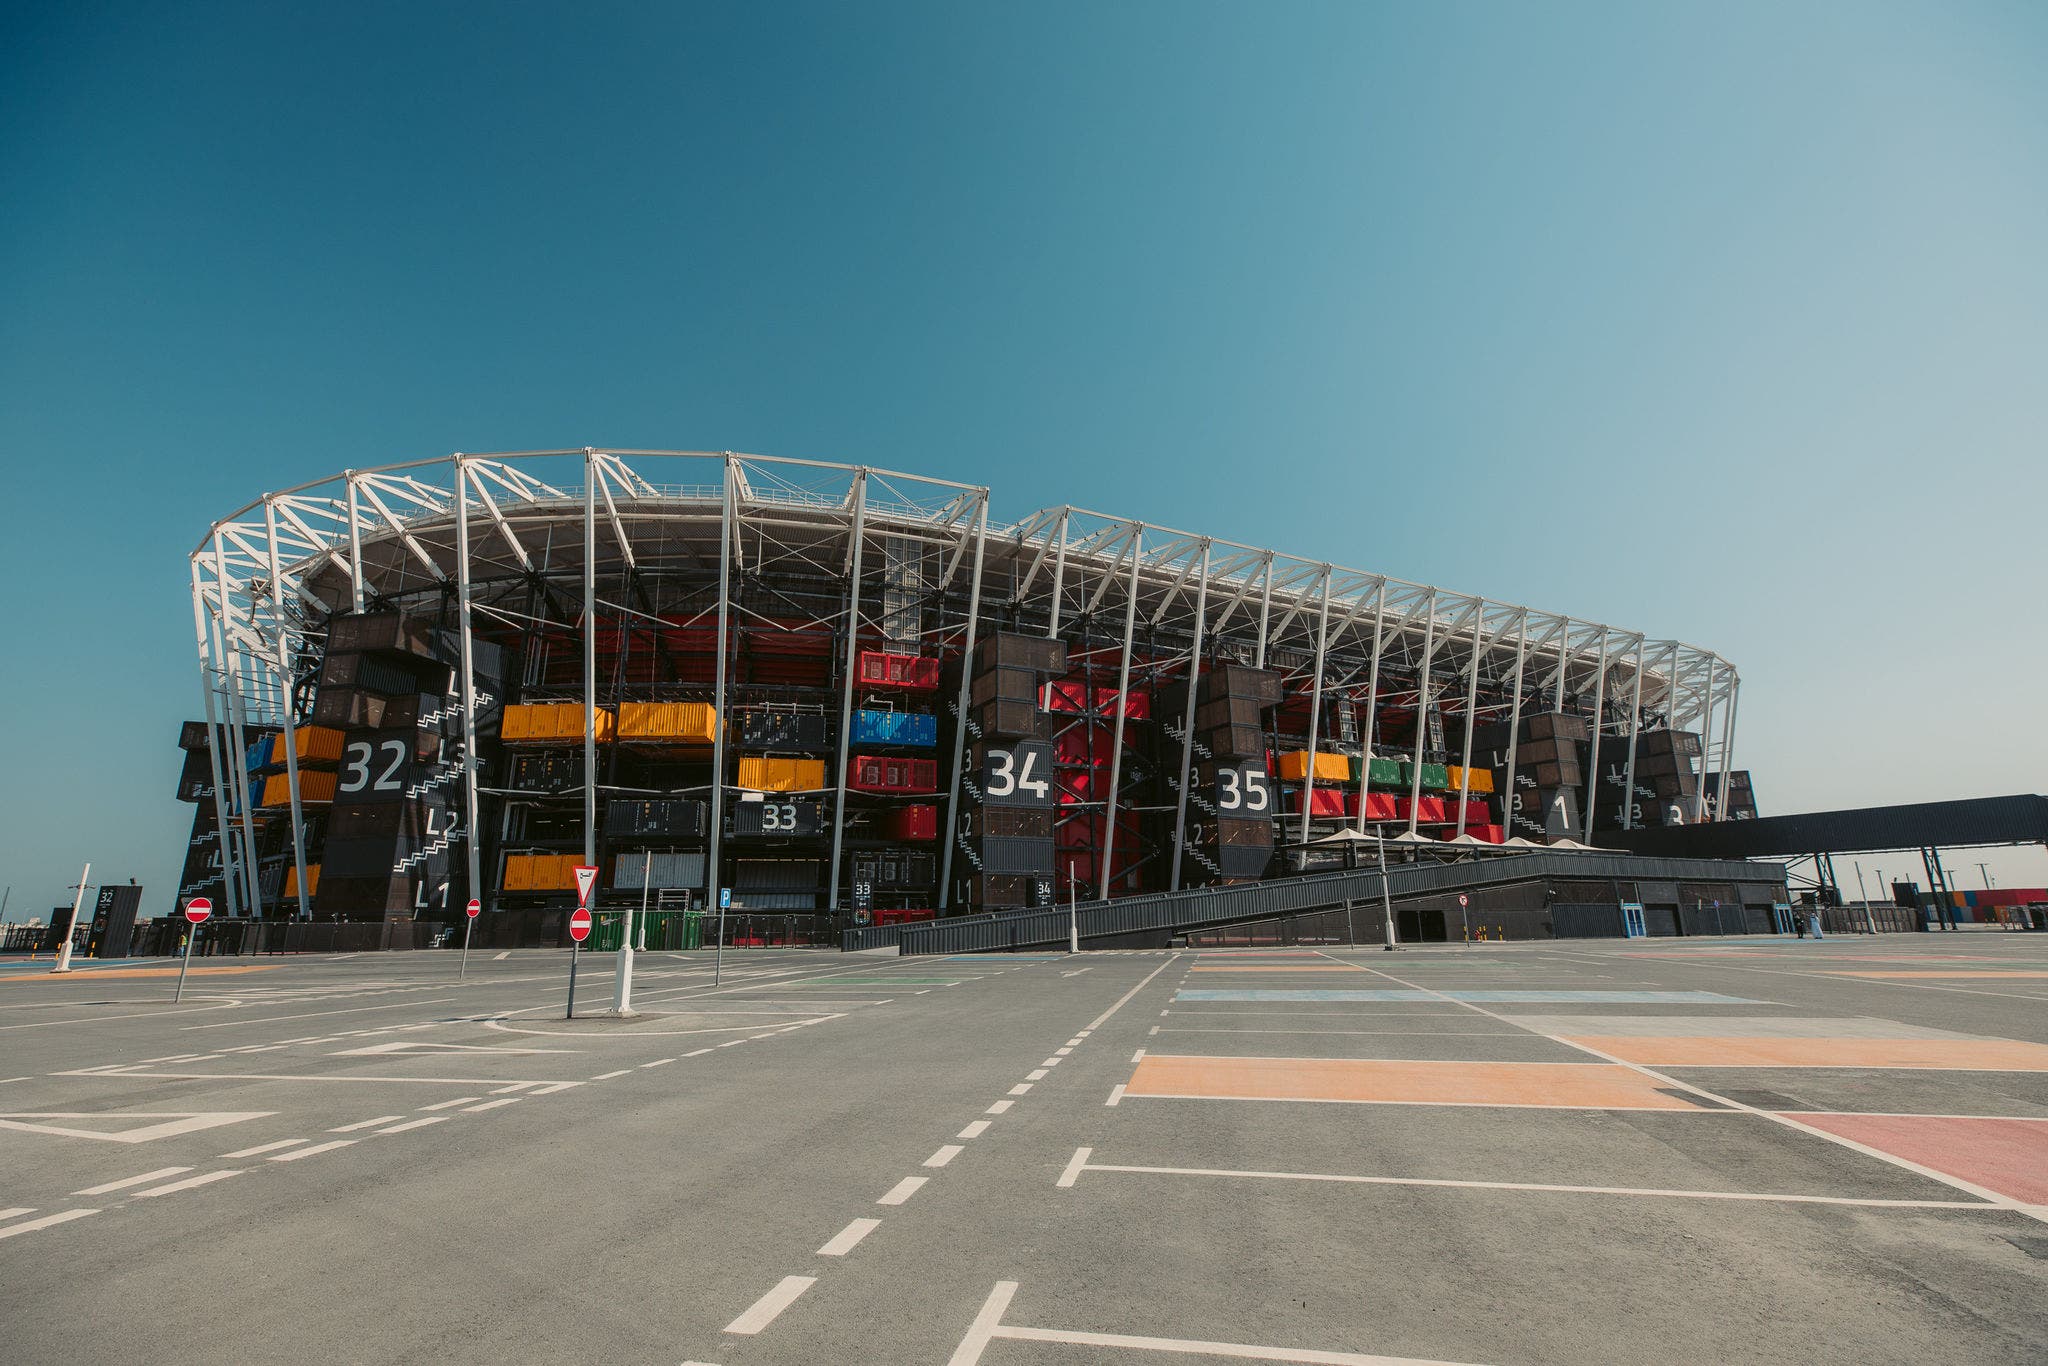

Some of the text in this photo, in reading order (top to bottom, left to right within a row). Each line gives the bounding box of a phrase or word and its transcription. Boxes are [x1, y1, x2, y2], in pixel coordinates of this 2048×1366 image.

[340, 740, 406, 792] 32
[987, 749, 1049, 798] 34
[1217, 769, 1269, 811] 35
[426, 808, 460, 838] L2
[762, 804, 798, 831] 33
[1554, 796, 1569, 829] 1
[100, 892, 114, 903] 32
[415, 880, 450, 908] L1
[855, 884, 871, 895] 33
[957, 879, 973, 904] L1
[1038, 883, 1051, 894] 34
